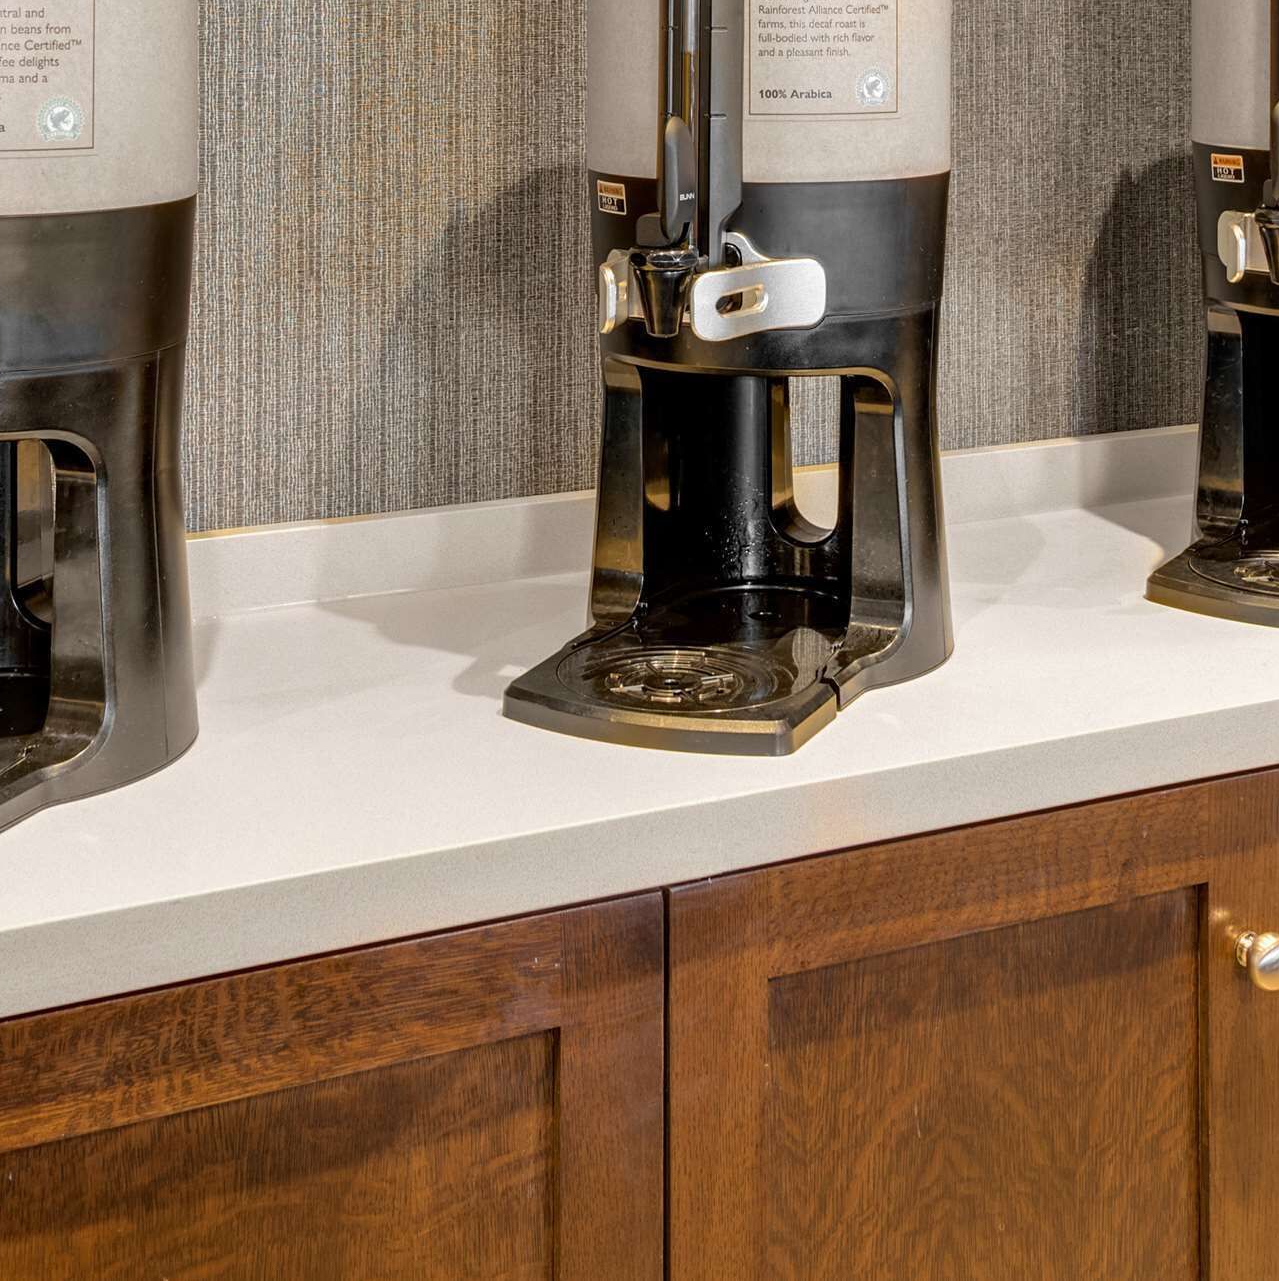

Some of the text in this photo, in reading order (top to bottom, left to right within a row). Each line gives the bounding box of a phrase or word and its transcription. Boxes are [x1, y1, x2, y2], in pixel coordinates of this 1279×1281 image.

[25, 8, 44, 18] and
[758, 5, 805, 14] Rainforest
[809, 5, 842, 14] Alliance
[11, 24, 42, 34] beans
[46, 24, 71, 34] from
[758, 20, 786, 29] farms,
[789, 20, 805, 28] this
[809, 19, 832, 28] decaf
[859, 20, 865, 28] is
[758, 33, 874, 42] full-bodied with rich flavor
[758, 48, 775, 56] and
[786, 48, 823, 58] pleasant
[826, 47, 851, 56] finish.
[19, 57, 59, 69] delights
[19, 73, 38, 83] and
[759, 89, 832, 99] 100% Arabica
